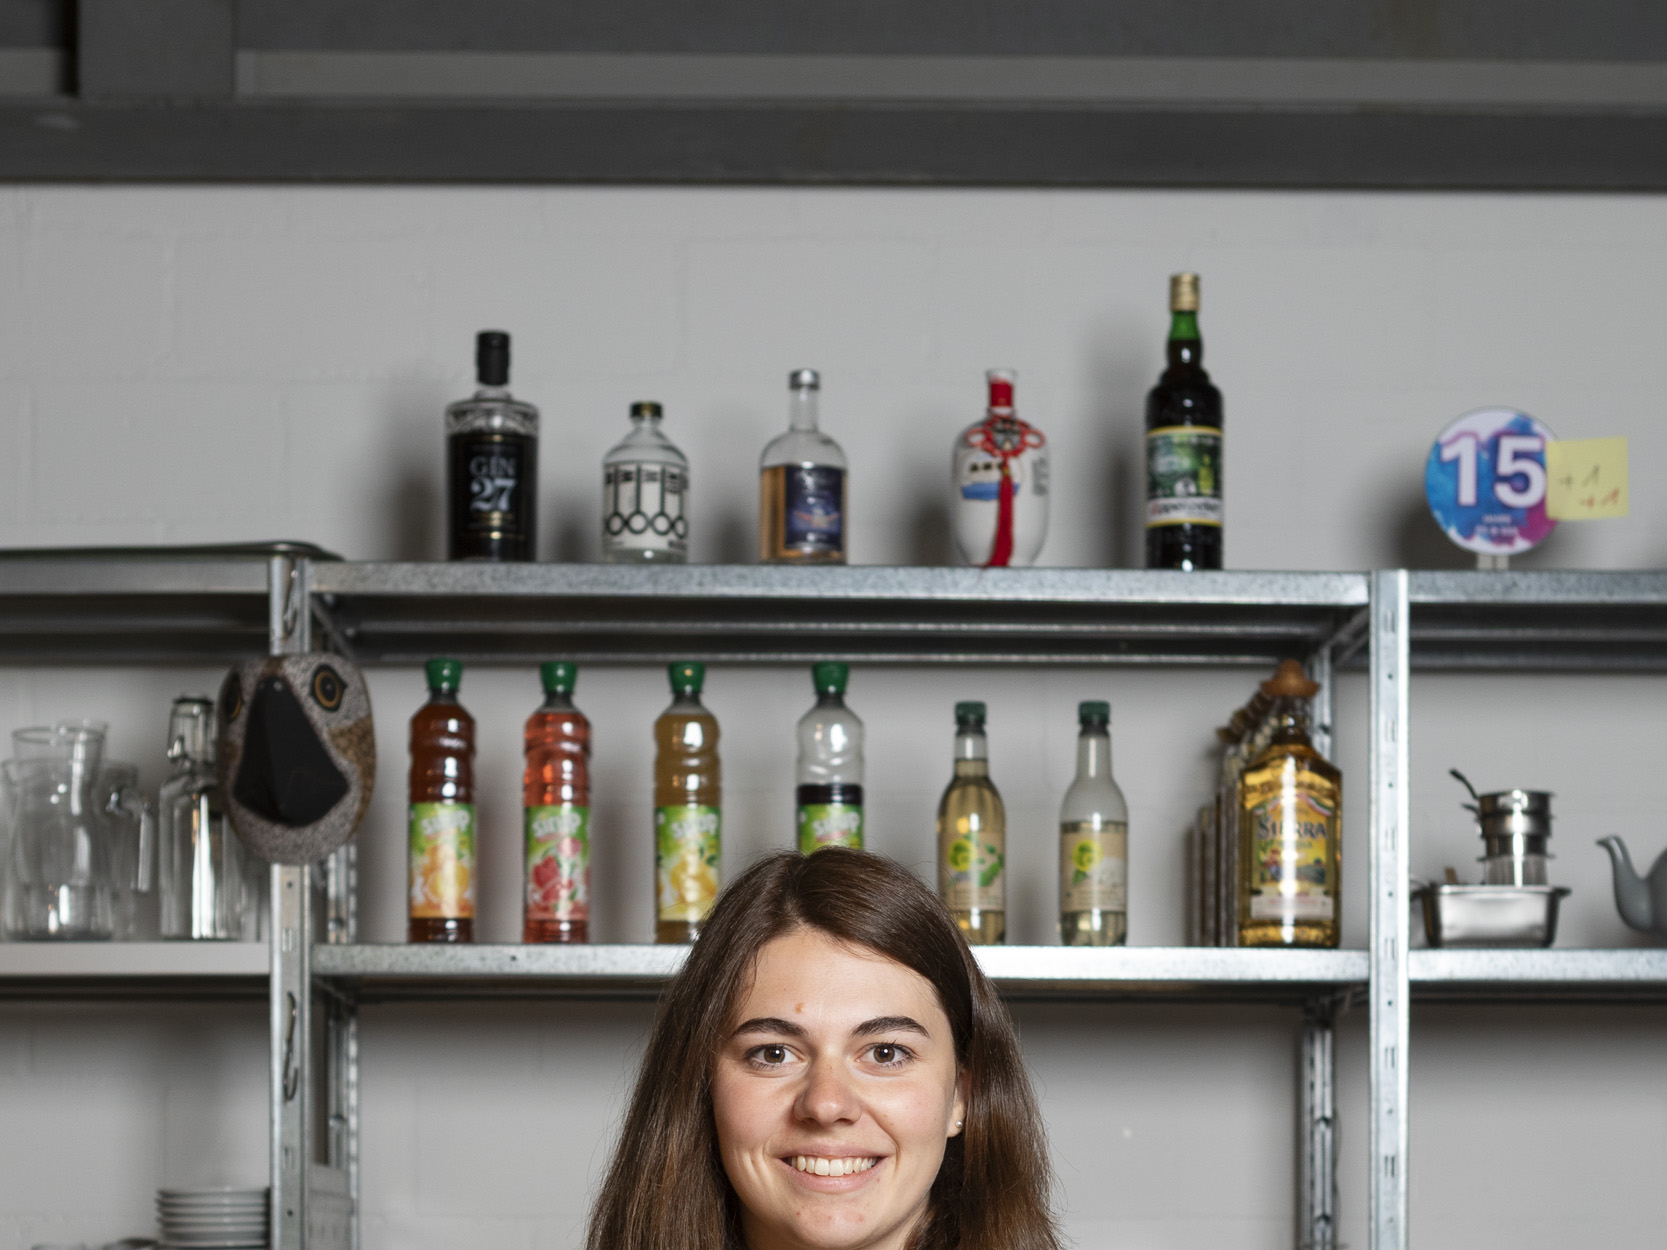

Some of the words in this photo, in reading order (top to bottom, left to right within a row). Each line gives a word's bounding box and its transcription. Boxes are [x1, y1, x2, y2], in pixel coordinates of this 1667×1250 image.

[470, 457, 516, 477] GIN
[1441, 434, 1547, 508] 15
[470, 477, 516, 511] 27
